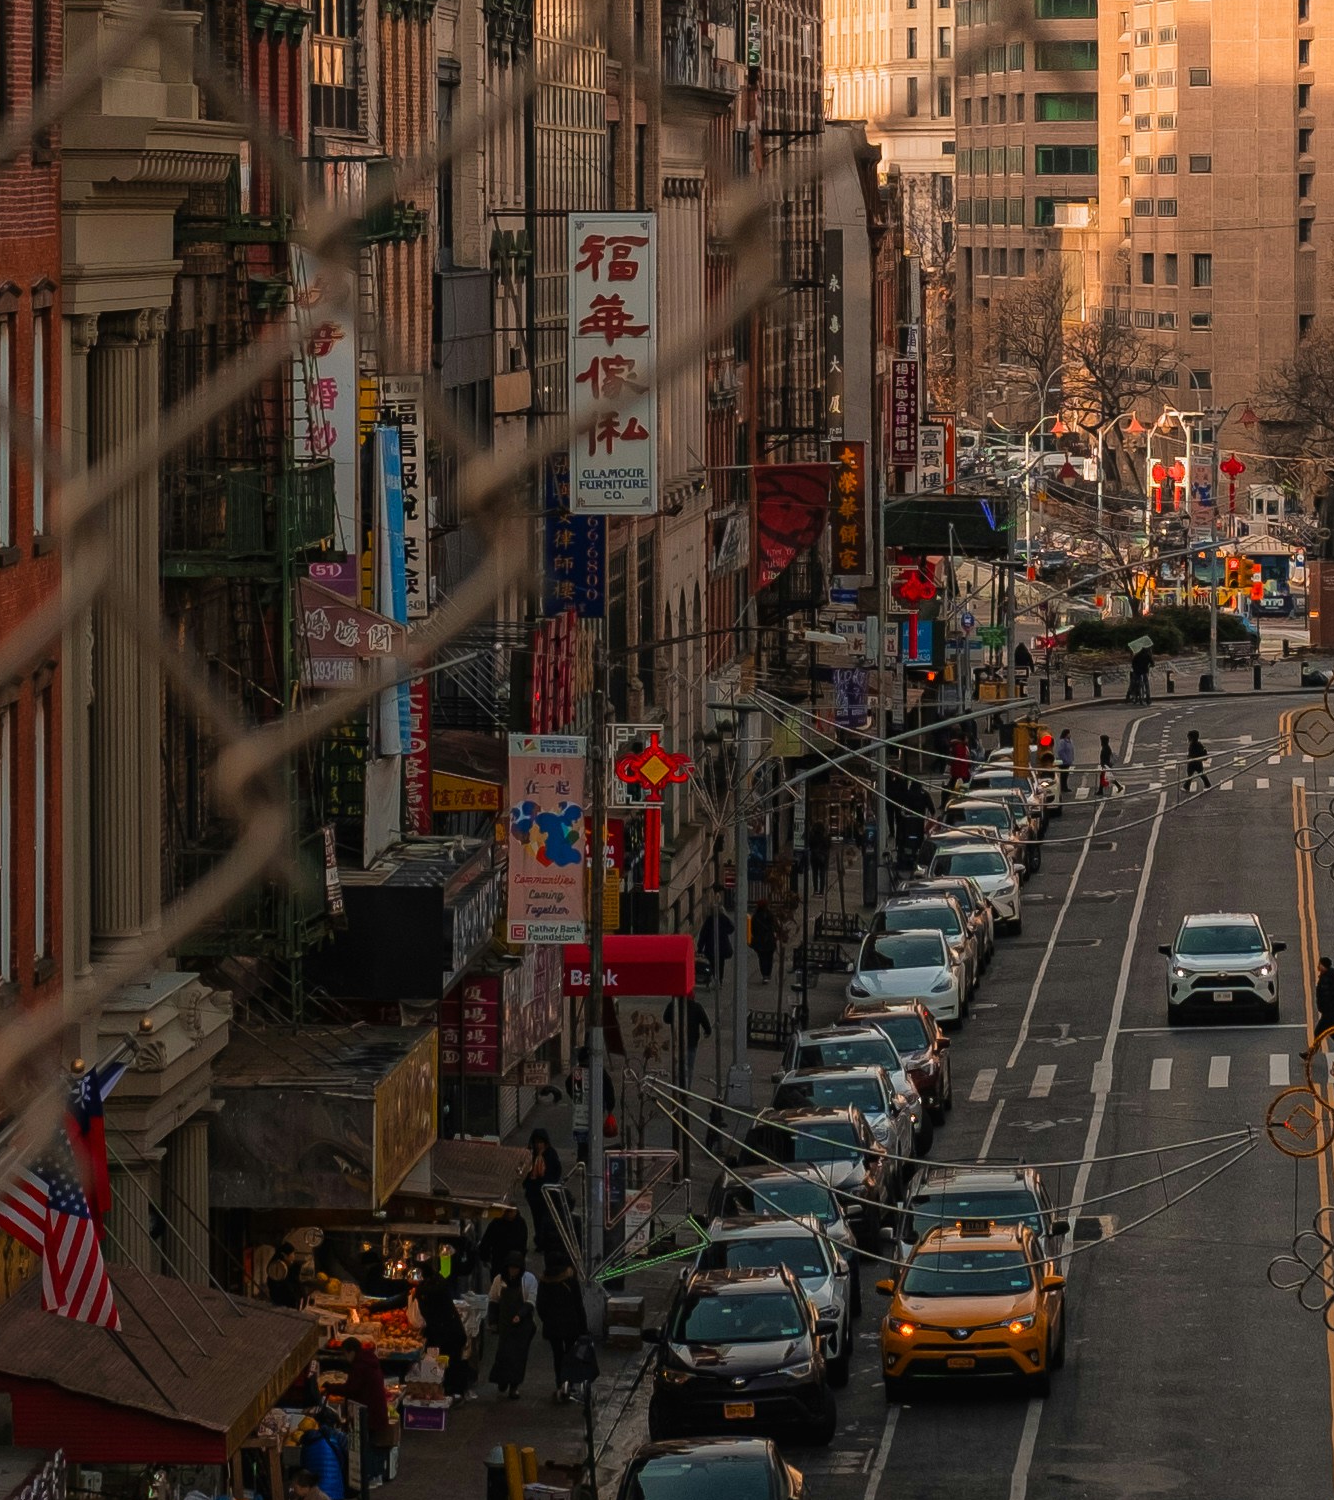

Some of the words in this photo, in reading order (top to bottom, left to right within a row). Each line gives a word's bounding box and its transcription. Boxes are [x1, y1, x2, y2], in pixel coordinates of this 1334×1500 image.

[575, 235, 650, 458] 福華傢俬
[582, 469, 645, 479] GLAMOUR
[579, 479, 649, 490] FURNITURE
[604, 490, 624, 500] CO.
[534, 763, 562, 775] 我們
[525, 780, 571, 796] 在一起
[514, 875, 576, 885] Communities
[528, 889, 565, 903] Coming
[525, 903, 570, 918] Together
[528, 924, 558, 936] Cathay
[560, 925, 582, 934] Bank
[528, 934, 575, 942] Foundation
